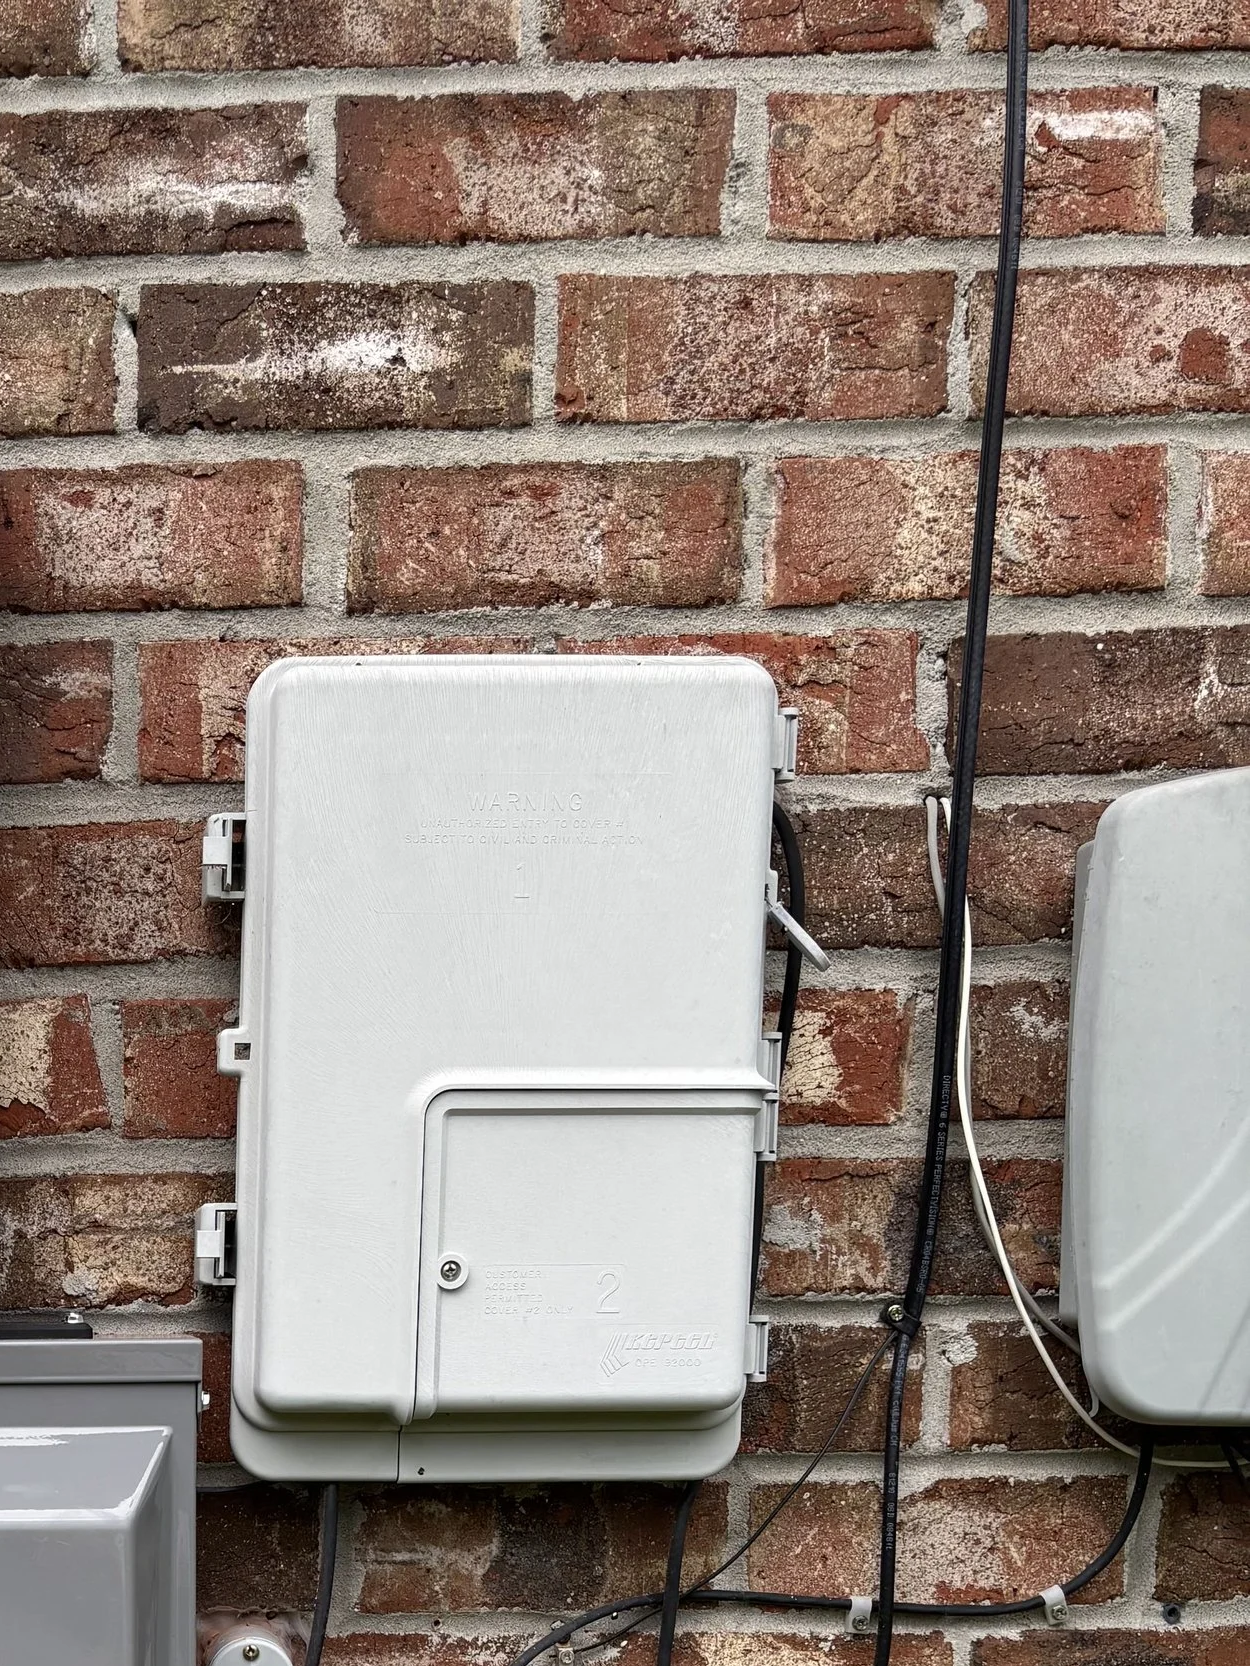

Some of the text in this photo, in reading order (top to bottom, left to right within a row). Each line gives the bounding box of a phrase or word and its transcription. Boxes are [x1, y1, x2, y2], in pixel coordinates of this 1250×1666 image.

[470, 791, 585, 812] WARNING
[420, 818, 507, 829] UNAUTHORIZED
[511, 818, 548, 829] ENTRY
[553, 818, 567, 829] TO
[572, 818, 611, 829] COVER
[404, 833, 458, 845] SUBJECT
[478, 833, 510, 845] CIVIL
[514, 834, 538, 845] AND
[542, 834, 599, 845] CRIMINAL
[935, 1131, 945, 1161] SERIES
[485, 1270, 542, 1279] CUSTOMER
[485, 1282, 527, 1291] ACCESS
[595, 1270, 621, 1315] 2
[484, 1306, 519, 1315] COVER
